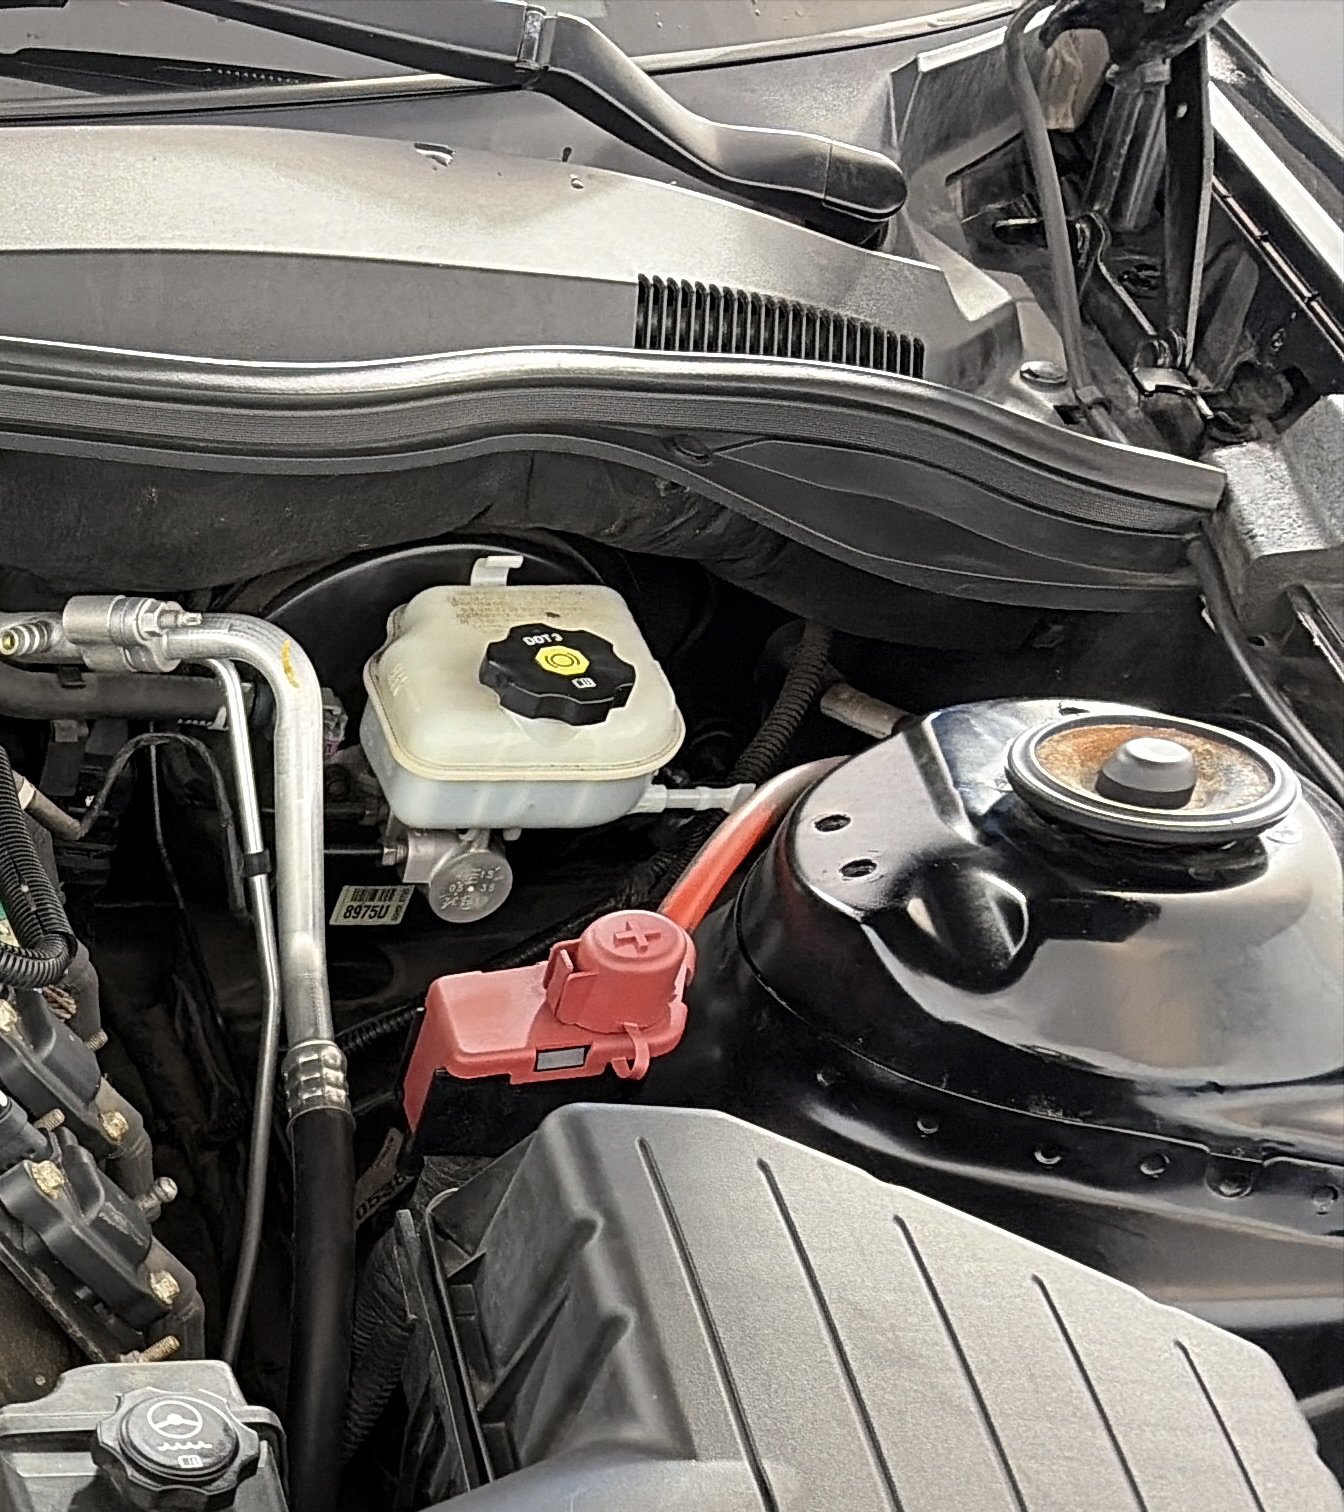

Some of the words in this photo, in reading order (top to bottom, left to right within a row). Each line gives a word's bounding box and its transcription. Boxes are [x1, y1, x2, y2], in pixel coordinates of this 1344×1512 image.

[523, 633, 552, 646] DOT
[551, 633, 563, 642] 3
[343, 905, 390, 919] 8975U
